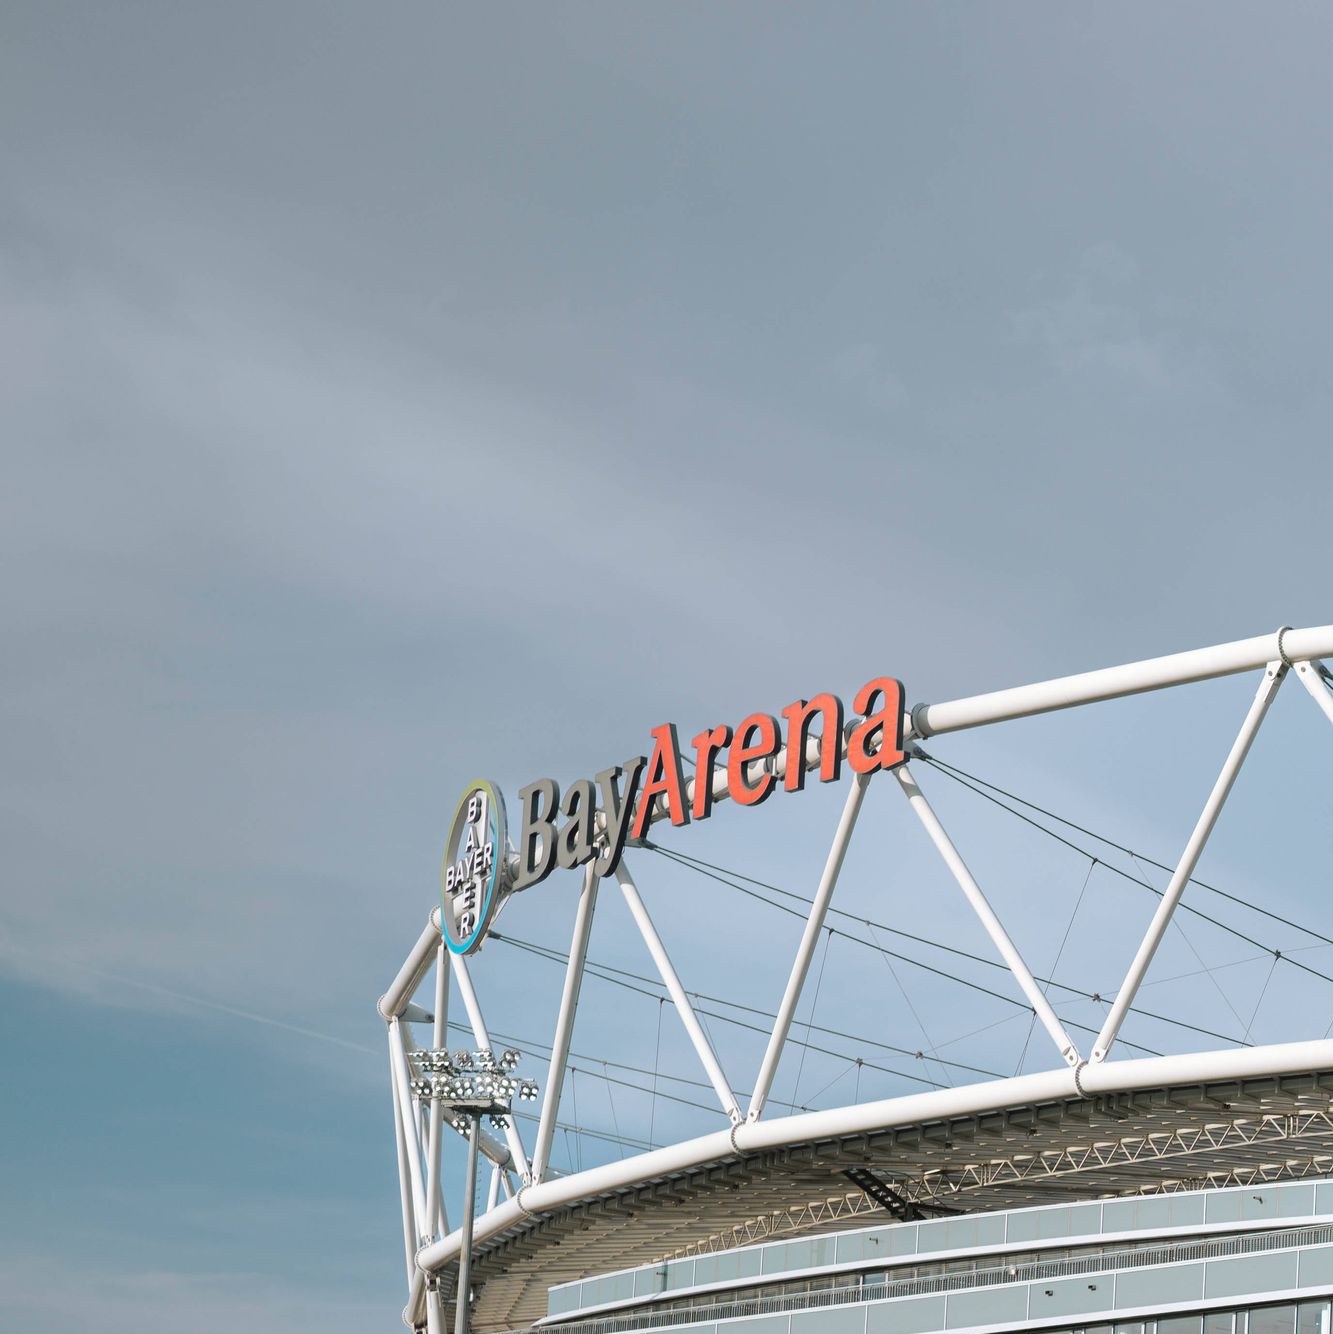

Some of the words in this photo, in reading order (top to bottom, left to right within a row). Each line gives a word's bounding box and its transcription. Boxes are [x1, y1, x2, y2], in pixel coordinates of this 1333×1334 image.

[512, 677, 909, 891] BayArena
[446, 842, 493, 892] BAYER
[459, 797, 483, 938] BAYER
